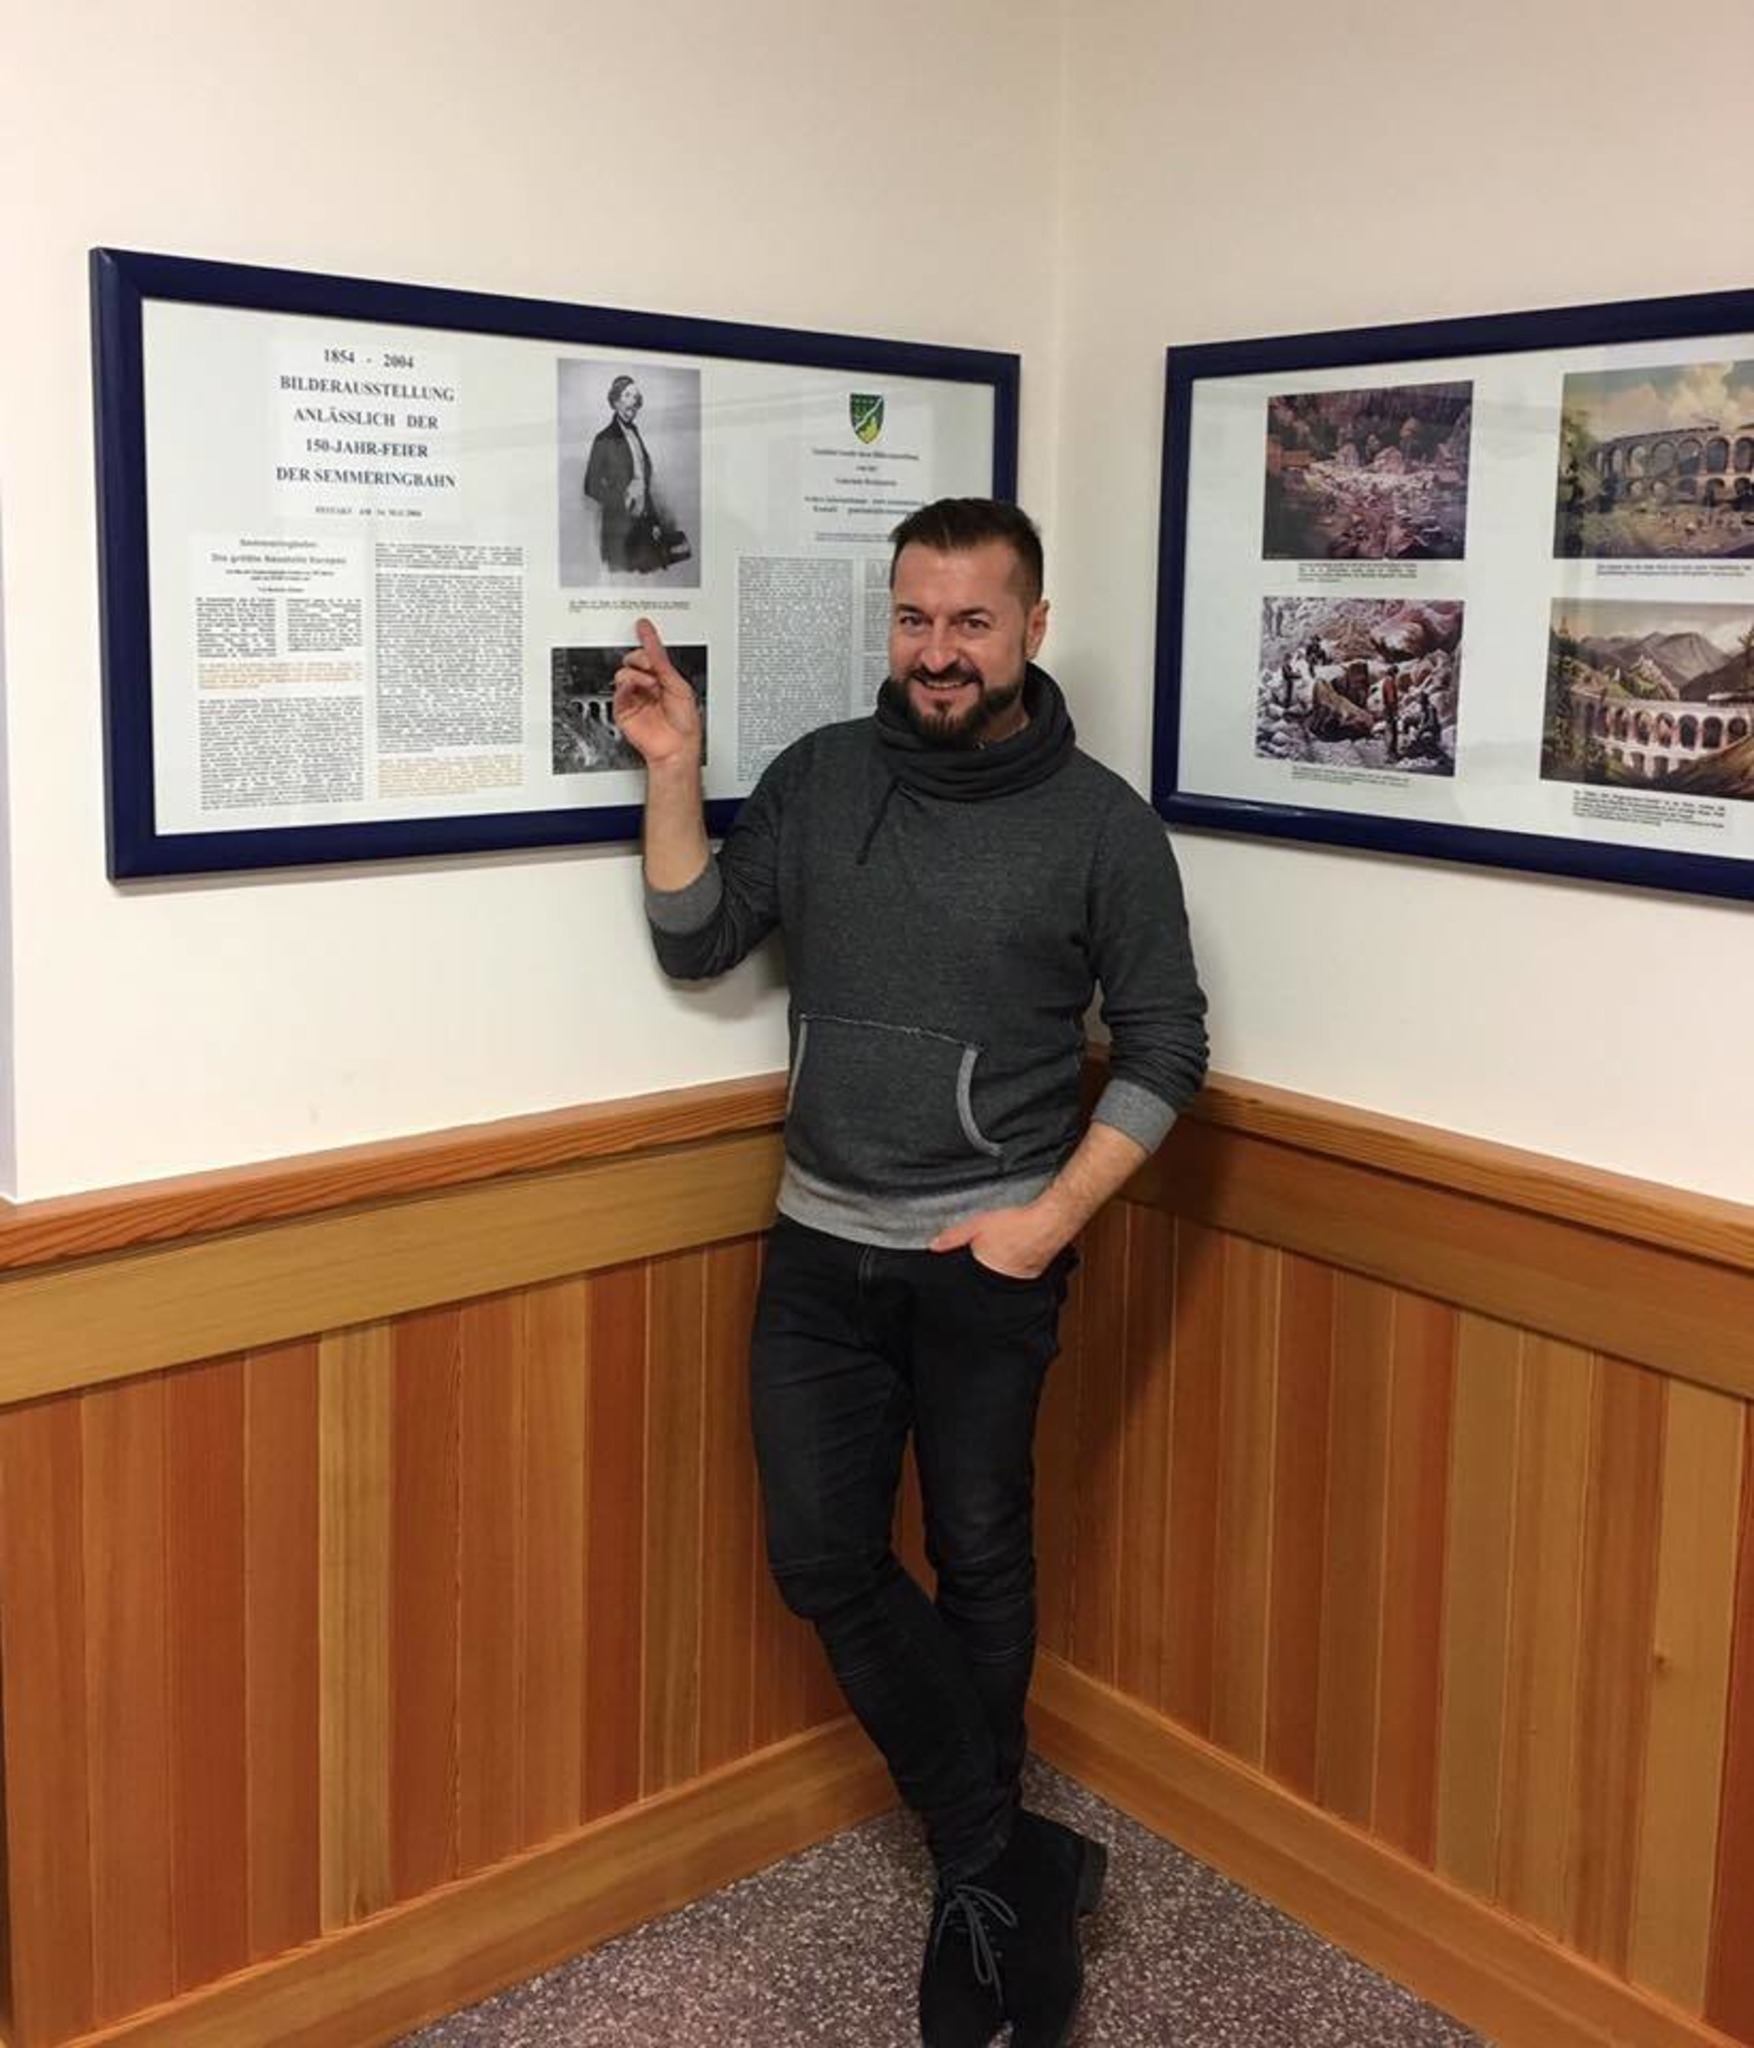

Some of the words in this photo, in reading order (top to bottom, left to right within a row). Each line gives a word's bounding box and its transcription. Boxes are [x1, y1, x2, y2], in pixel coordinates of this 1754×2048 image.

[323, 349, 355, 364] 1854
[383, 353, 414, 368] 2004
[280, 375, 455, 402] BILDERAUSSTELLUNG
[294, 407, 395, 427] ANLÄSSLICH
[407, 415, 439, 430] DER
[306, 438, 428, 458] 150-JAHR-FEIER
[276, 467, 310, 482] DER
[314, 468, 456, 488] SEMMERINGBAHN
